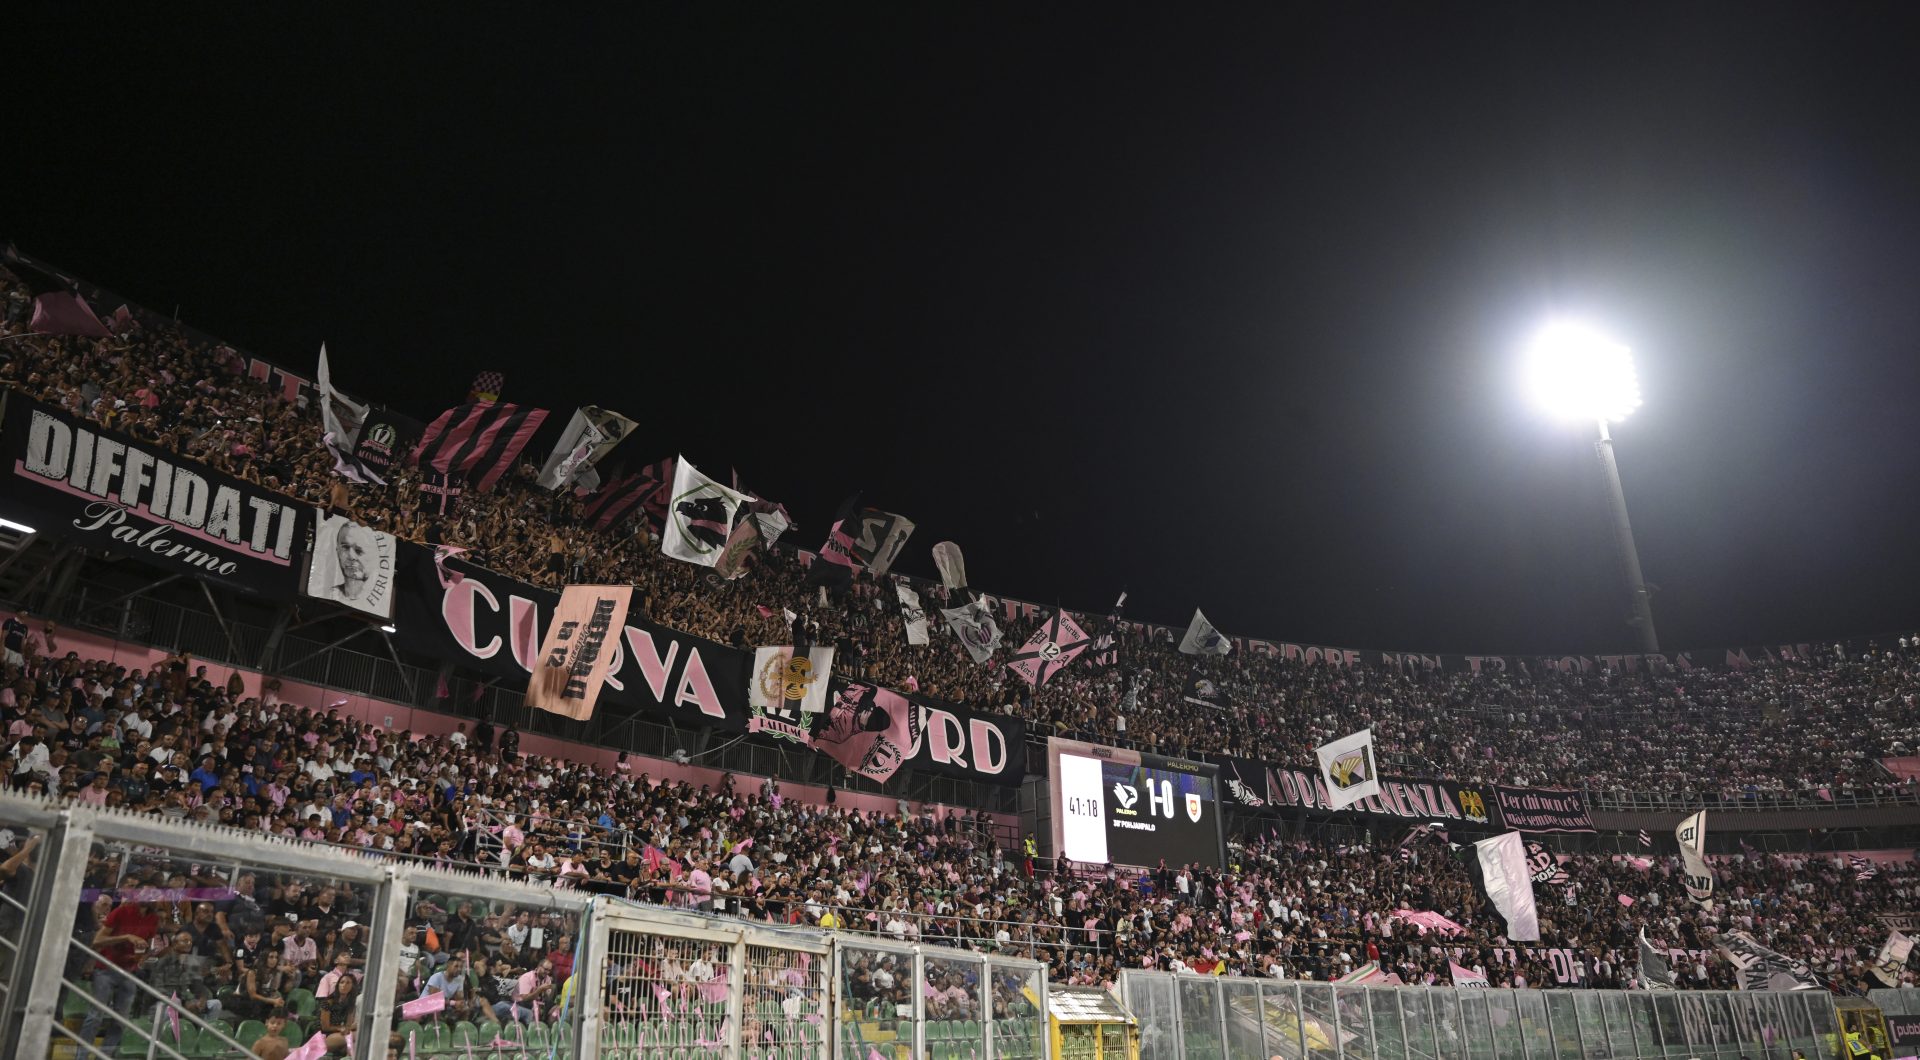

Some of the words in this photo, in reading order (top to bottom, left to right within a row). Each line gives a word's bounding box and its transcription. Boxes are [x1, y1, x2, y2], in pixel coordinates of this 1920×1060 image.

[25, 409, 296, 560] DIFFIDATI
[72, 500, 237, 576] Palermo
[366, 574, 388, 607] FIERI
[379, 554, 390, 571] DI
[442, 577, 726, 718] CUVA
[545, 647, 566, 669] 12
[1167, 760, 1200, 772] PALERMO
[1069, 796, 1098, 818] 41:18
[1115, 807, 1138, 816] PALERMO
[1146, 777, 1175, 819] 1-0
[1265, 766, 1462, 820] APPAENENZA
